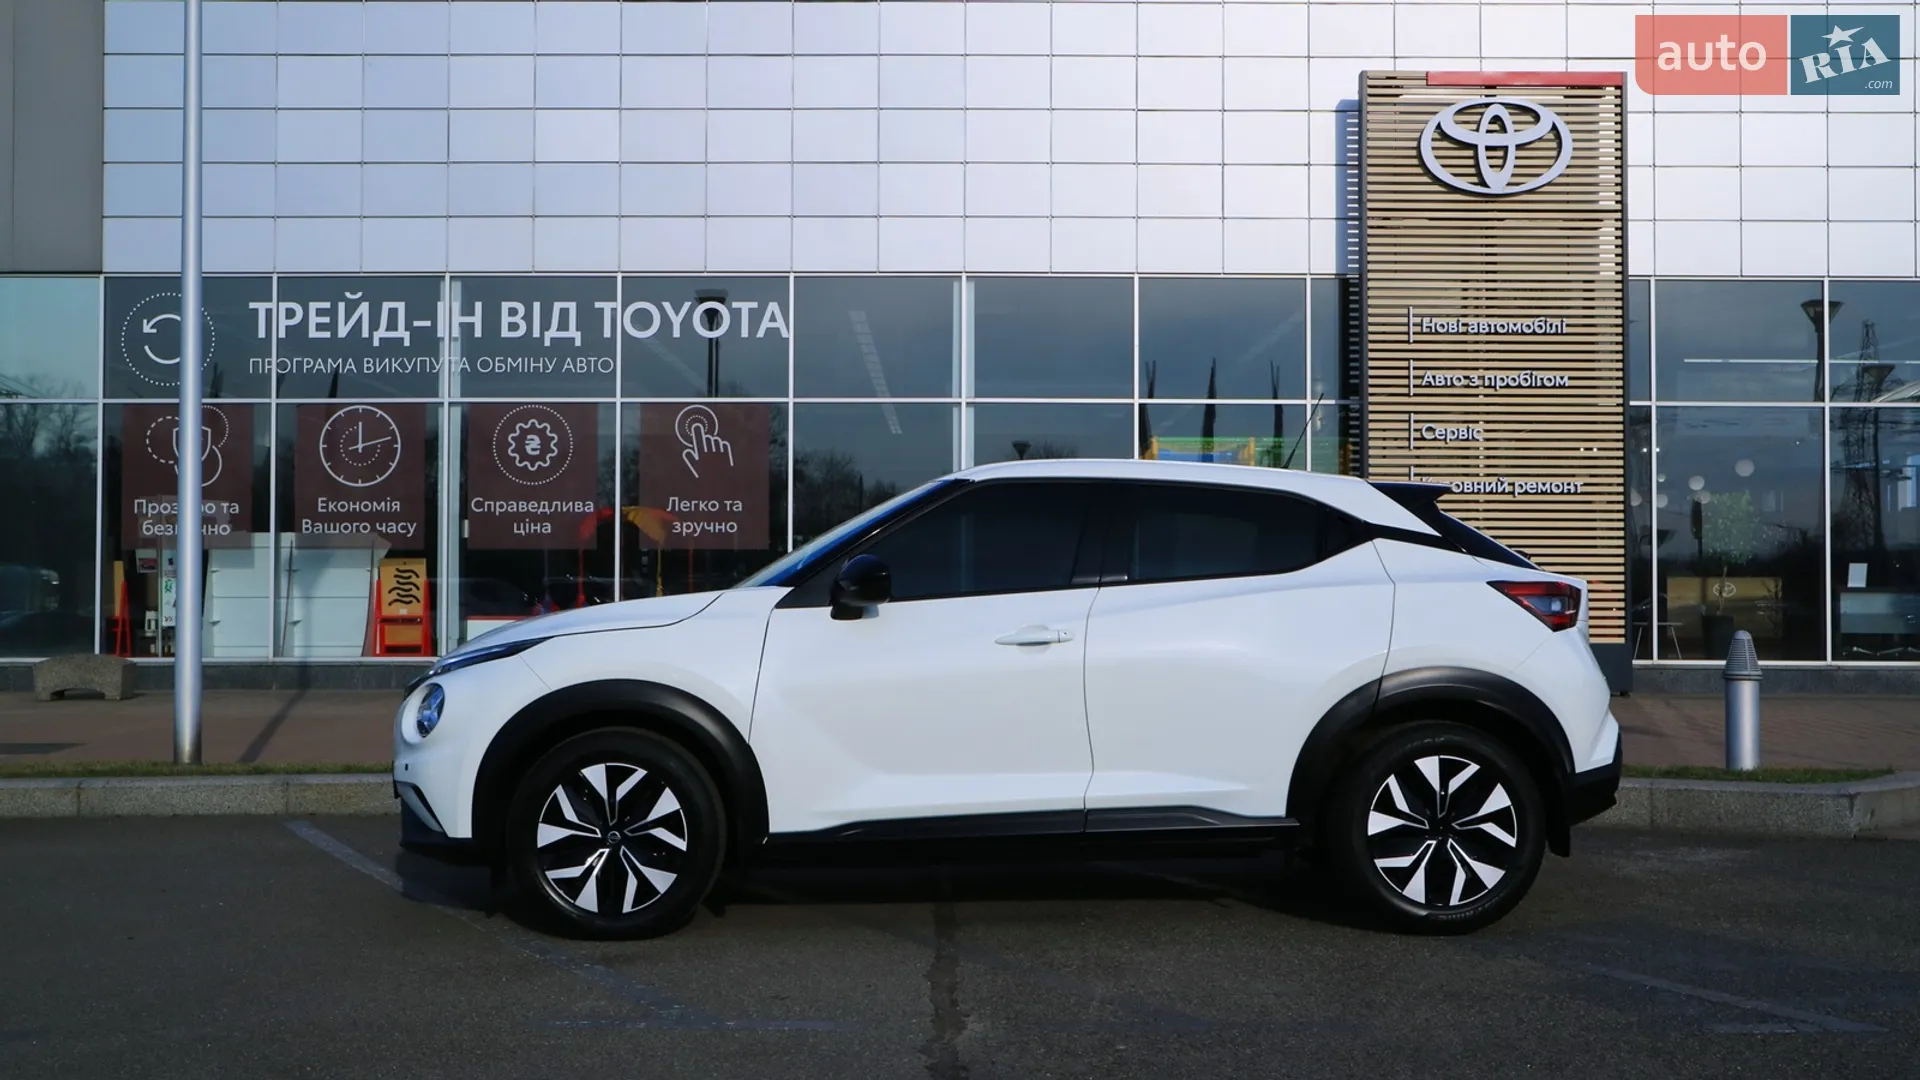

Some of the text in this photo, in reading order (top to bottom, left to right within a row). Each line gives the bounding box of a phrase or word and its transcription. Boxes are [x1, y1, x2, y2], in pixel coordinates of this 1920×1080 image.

[248, 291, 790, 347] ТРЕЙД-ІН ВІД TOYOTA
[1421, 317, 1567, 334] Нові автомобілі
[248, 357, 614, 374] ПРОГРАМА ВИКУПУ ТА ОБМІНУ АВТО
[1421, 371, 1569, 391] Авто з пробігом
[1420, 424, 1484, 442] Сервіс
[1514, 481, 1584, 496] ремонт
[220, 502, 240, 514] та
[317, 497, 401, 513] Економія
[470, 497, 595, 516] Справедлива
[666, 496, 743, 512] Легко та
[302, 519, 417, 538] Вашого часу
[513, 519, 552, 537] ціна
[672, 521, 738, 537] зручно
